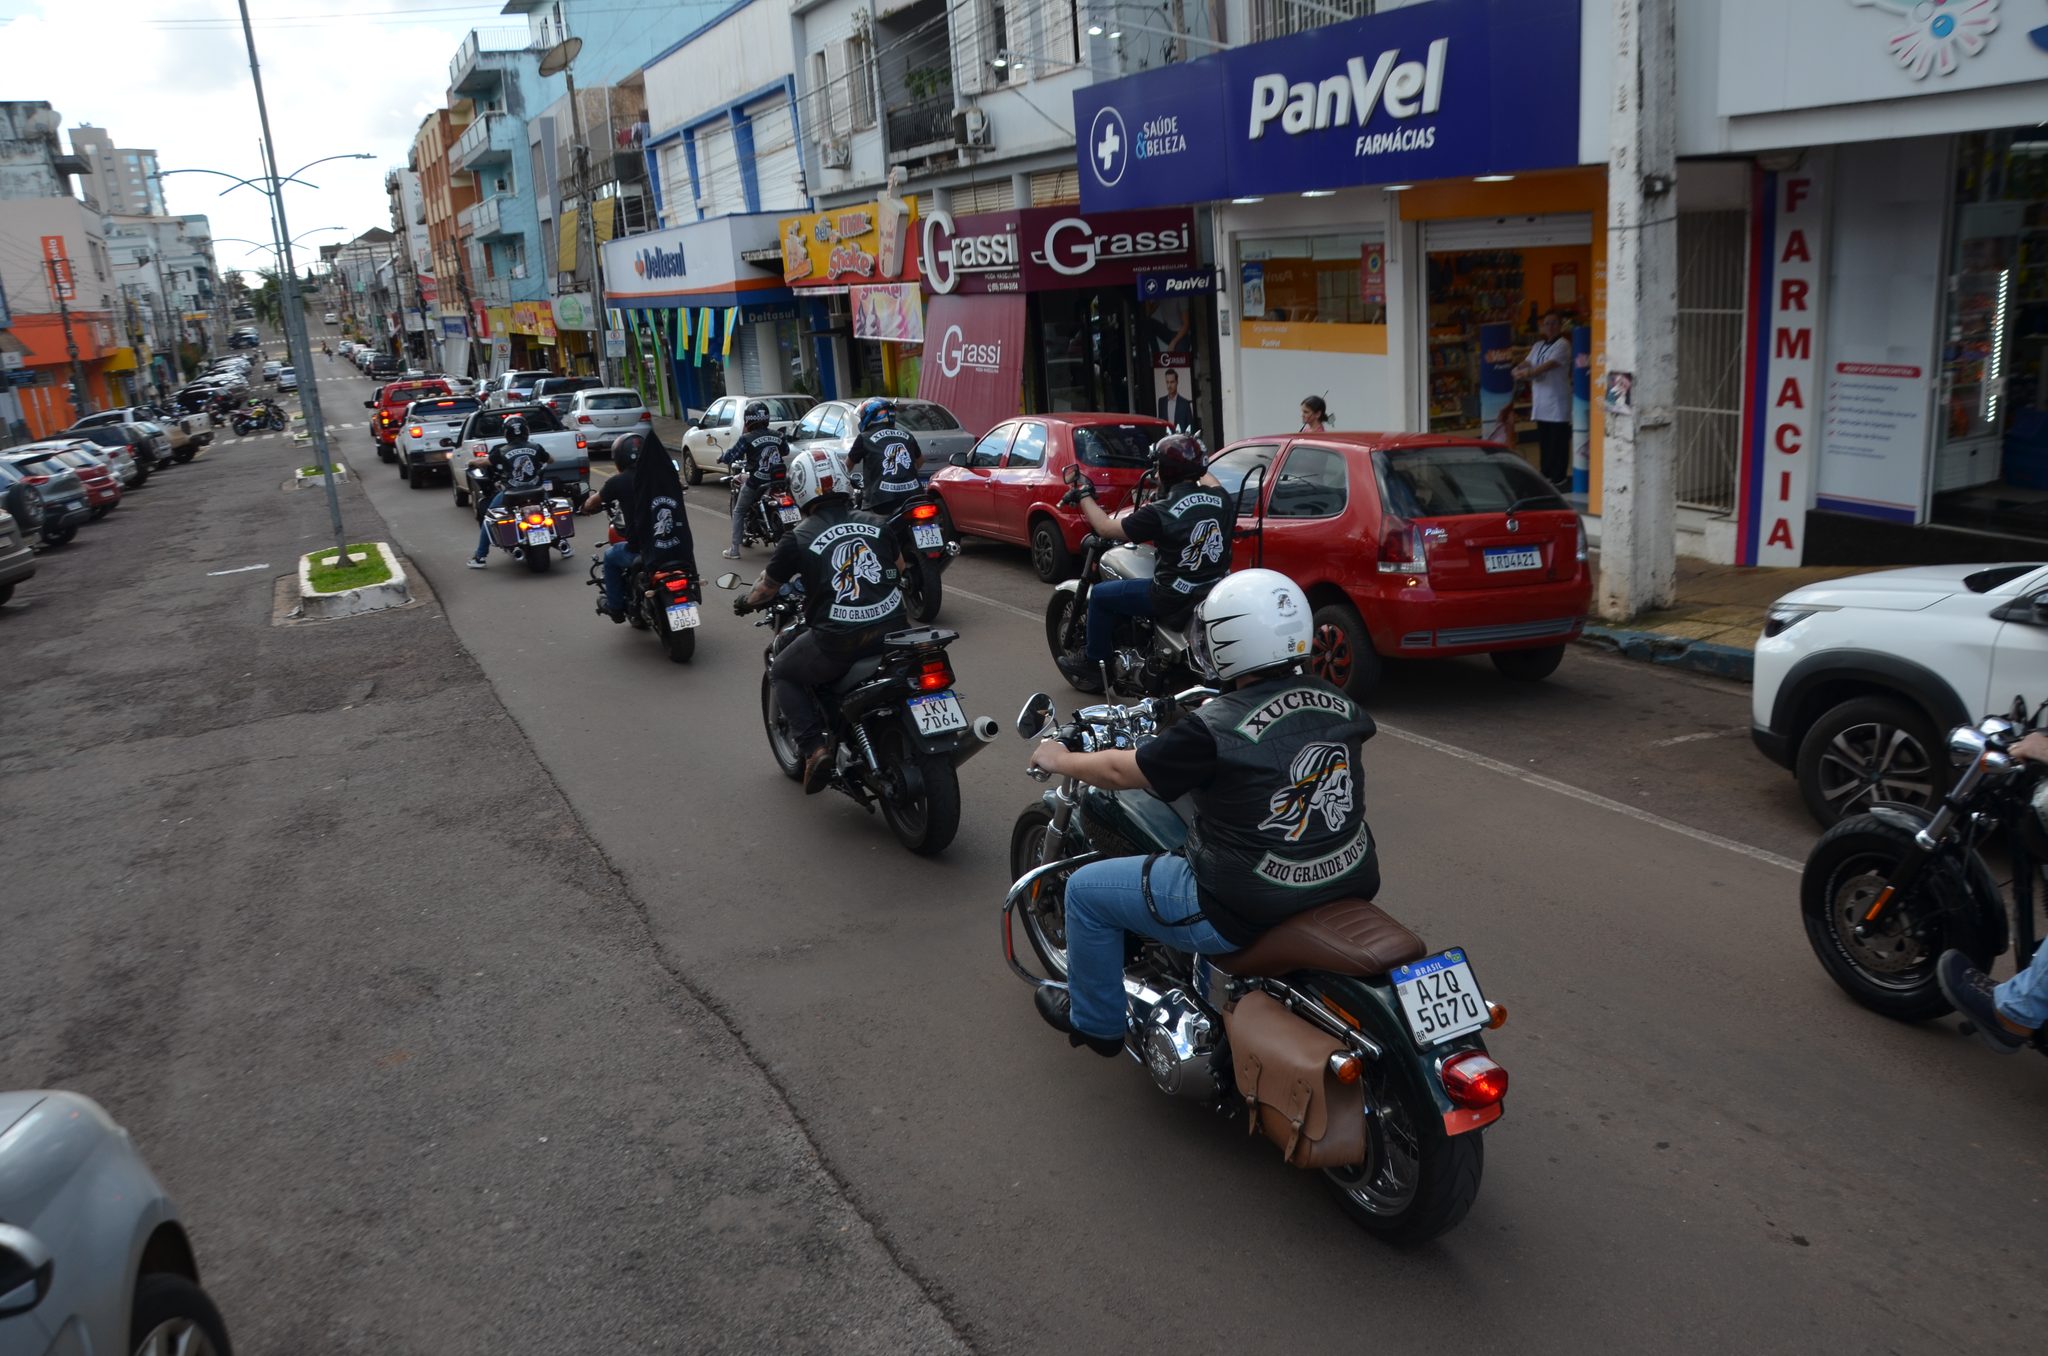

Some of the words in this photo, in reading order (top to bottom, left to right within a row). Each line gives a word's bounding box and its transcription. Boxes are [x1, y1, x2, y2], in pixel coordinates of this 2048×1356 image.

[1249, 37, 1449, 140] PanVel
[1143, 115, 1178, 139] SAÚDE
[1147, 134, 1187, 157] BELEZA
[1355, 126, 1436, 157] FARMÁCIAS
[917, 209, 1019, 294] Grassi
[1031, 217, 1189, 276] Grassi
[642, 241, 687, 281] Deltasul
[1165, 276, 1210, 292] PanVel
[936, 324, 1001, 378] Grassi
[1766, 178, 1811, 550] FARMACIA
[874, 429, 908, 441] XUCROS
[1173, 494, 1221, 515] XUCROS
[814, 524, 877, 551] XUCROS
[1175, 579, 1188, 592] RIO
[832, 607, 847, 619] RIO
[848, 606, 881, 620] GRANDE
[880, 602, 890, 614] DO
[921, 699, 949, 717] IKV
[1246, 690, 1347, 736] XUCROS
[921, 713, 960, 731] 7D64
[1262, 859, 1292, 886] RIO
[1293, 848, 1344, 884] GRANDE
[1344, 841, 1360, 864] DO
[1414, 962, 1444, 977] BRASIL
[1416, 969, 1462, 1006] AZQ
[1417, 993, 1479, 1034] 5G70
[1416, 1030, 1427, 1041] BR
